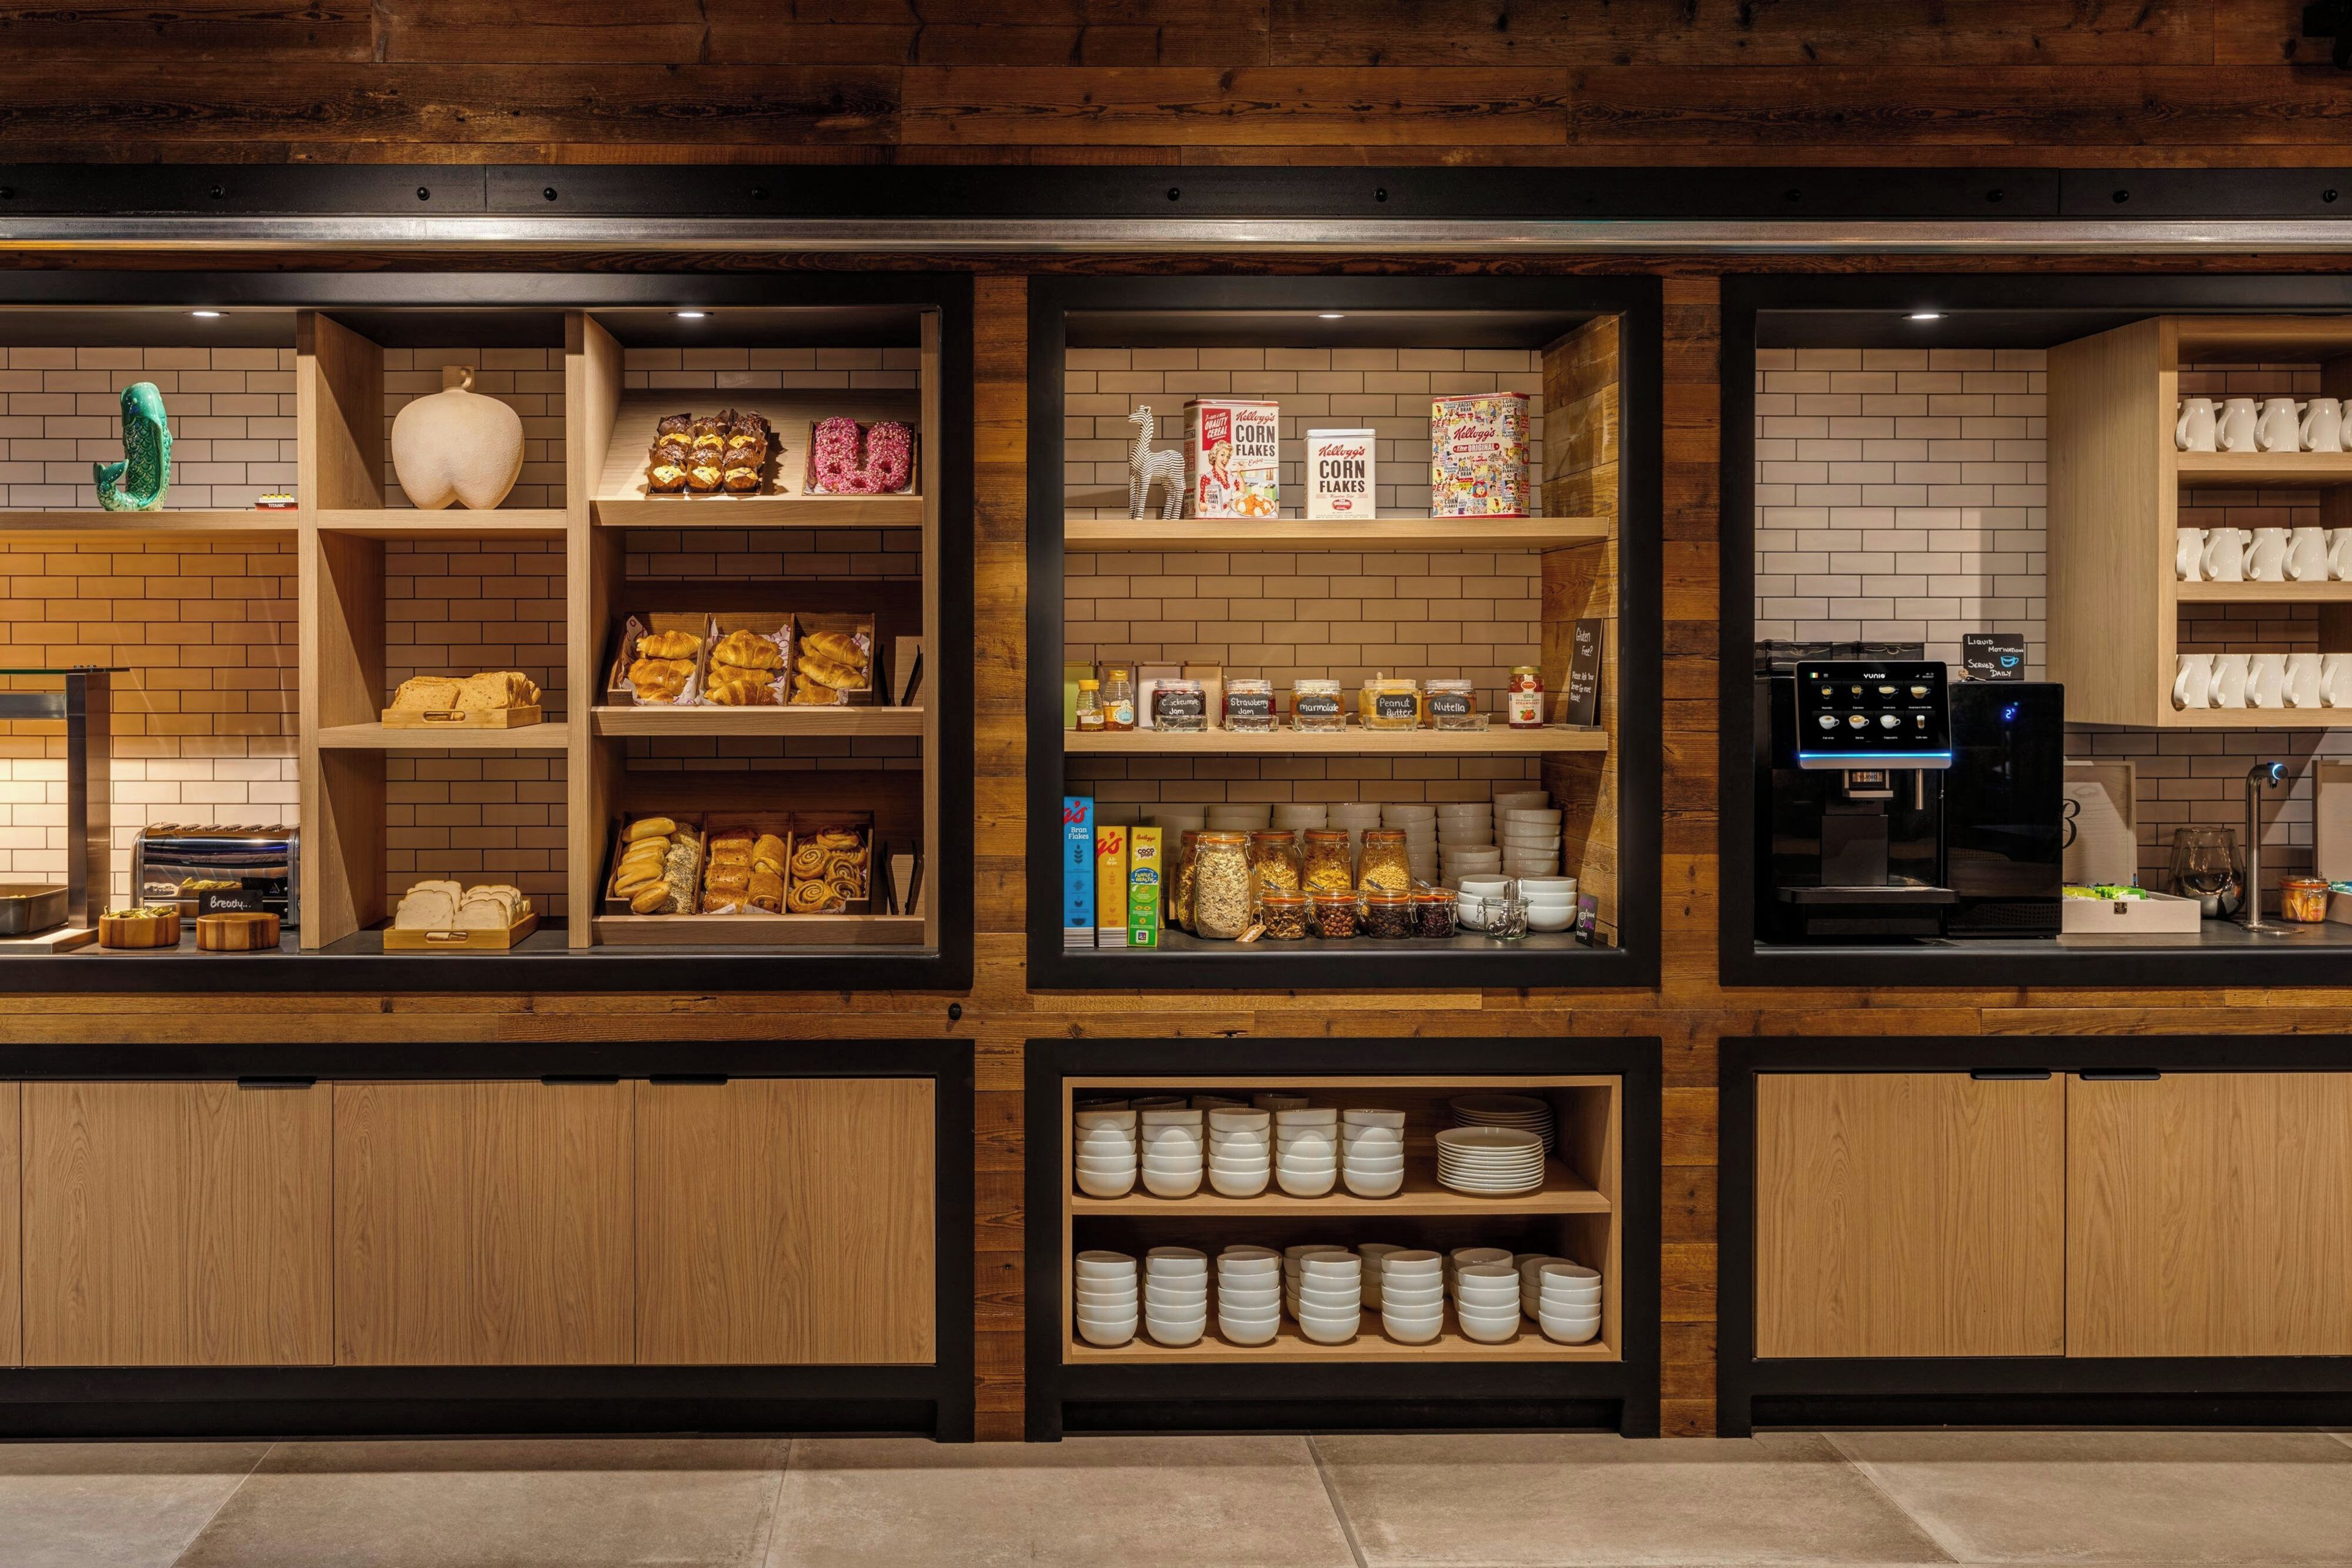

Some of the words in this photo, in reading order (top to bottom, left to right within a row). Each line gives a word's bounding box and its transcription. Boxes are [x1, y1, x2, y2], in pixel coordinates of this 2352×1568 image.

[1205, 417, 1228, 430] QUALITY
[1235, 410, 1275, 424] Kellogg's
[1207, 426, 1227, 439] CEREAL
[1235, 424, 1275, 443] CORN
[1453, 426, 1496, 442] Kellogg's
[1236, 444, 1275, 456] FLAKES
[1319, 443, 1365, 459] Kellogg's
[1468, 443, 1495, 451] ORIGINAL
[1319, 460, 1365, 478] CORN
[1320, 480, 1365, 492] FLAKES
[1576, 627, 1591, 643] Gluten
[1581, 646, 1593, 657] Free?
[1231, 698, 1268, 709] Strawberry
[1379, 698, 1410, 707] Peanut
[1434, 703, 1465, 712] Nutella
